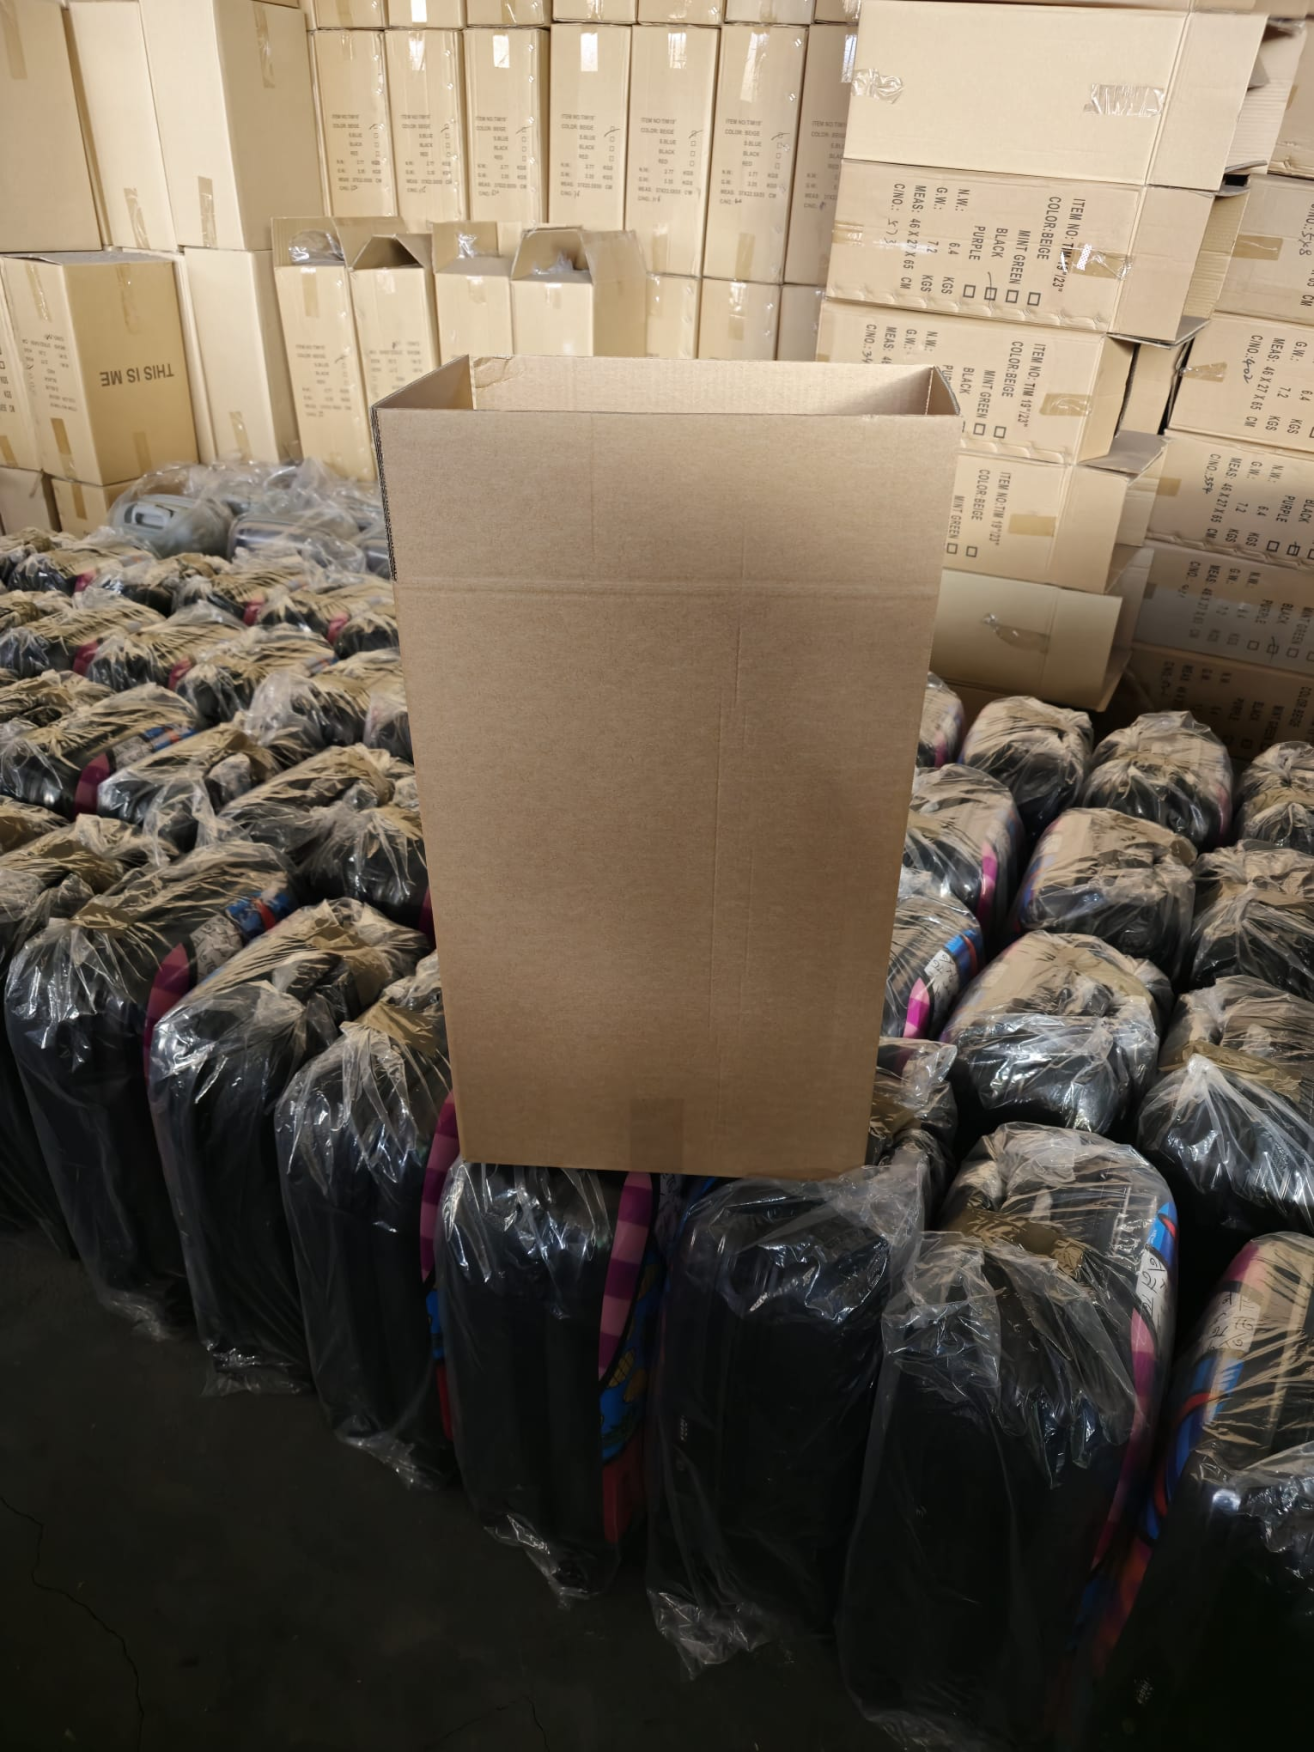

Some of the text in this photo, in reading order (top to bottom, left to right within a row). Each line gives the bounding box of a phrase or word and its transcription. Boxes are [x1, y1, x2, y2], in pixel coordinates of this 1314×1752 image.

[911, 185, 927, 213] MEAS:
[1069, 198, 1086, 220] ITEM
[909, 218, 921, 228] 46
[1037, 196, 1062, 260] COLOR:BEIGE
[920, 187, 948, 293] G.W.: 7.2 KGS
[941, 188, 970, 294] N.W.: 6.4 KGS
[968, 225, 986, 261] PURPLE
[991, 227, 1008, 258] BLACK
[903, 260, 914, 269] 65
[1009, 230, 1031, 285] MINT GREEN
[900, 277, 912, 289] CM
[883, 326, 897, 352] MEAS:
[1266, 338, 1285, 362] MEAS:
[1031, 343, 1046, 364] ITEM
[99, 363, 175, 387] THIS IS ME
[959, 367, 975, 395] BLACK
[1262, 366, 1275, 376] 46
[976, 370, 996, 419] MINT GREEN
[1022, 383, 1035, 397] TIM
[1257, 384, 1269, 393] 27
[1265, 341, 1308, 431] G.W.: 7.2 KGS
[1250, 401, 1263, 411] 65
[1287, 390, 1314, 435] 6.4 KGS
[1244, 416, 1258, 428] CM
[1224, 457, 1242, 479] MEAS:
[998, 472, 1011, 490] ITEM
[1221, 483, 1233, 492] 46
[1216, 499, 1228, 508] 27
[1257, 505, 1269, 517] 6.4
[1276, 494, 1296, 523] PURPLE
[1298, 499, 1314, 524] BLACK
[948, 495, 965, 539] MINT GREEN
[1210, 514, 1222, 523] 65
[1205, 528, 1218, 539] CM
[1225, 528, 1239, 543] KGS
[1245, 532, 1260, 547] KGS
[1255, 599, 1273, 624] PURPLE
[1277, 603, 1294, 624] BLACK
